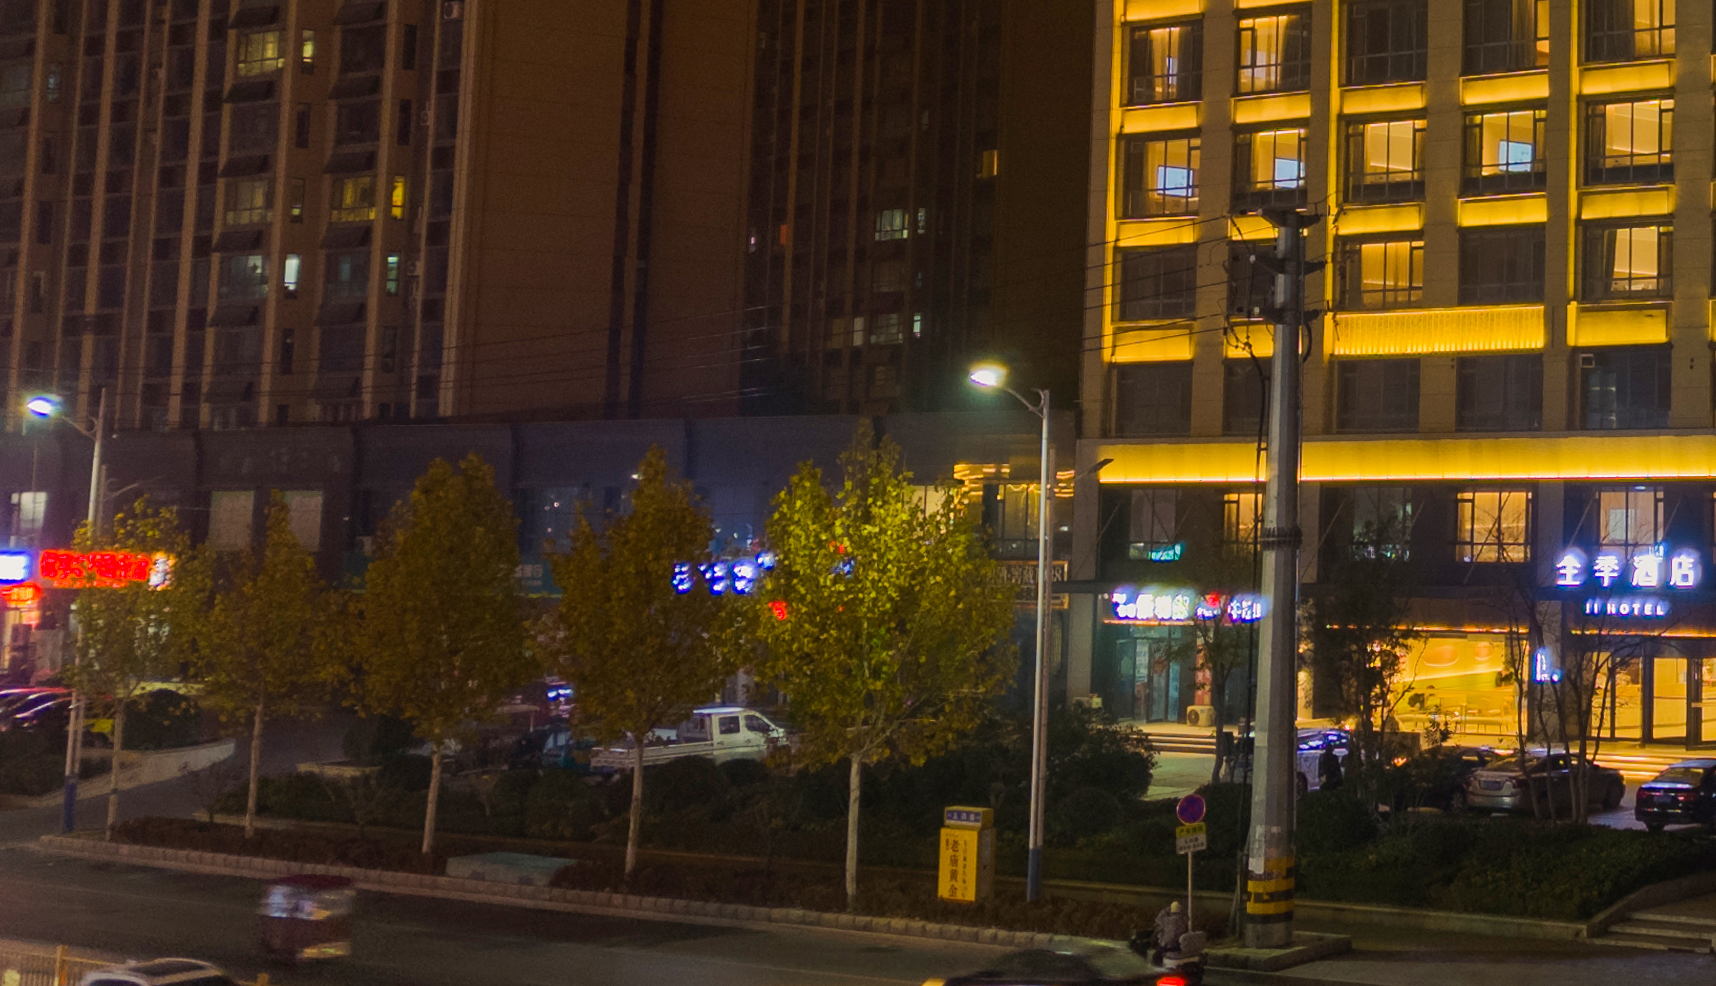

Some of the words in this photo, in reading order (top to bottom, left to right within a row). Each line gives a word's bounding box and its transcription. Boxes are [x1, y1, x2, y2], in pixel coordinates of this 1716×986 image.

[1555, 554, 1695, 587] 全季酒店
[1606, 602, 1665, 615] HOTEL
